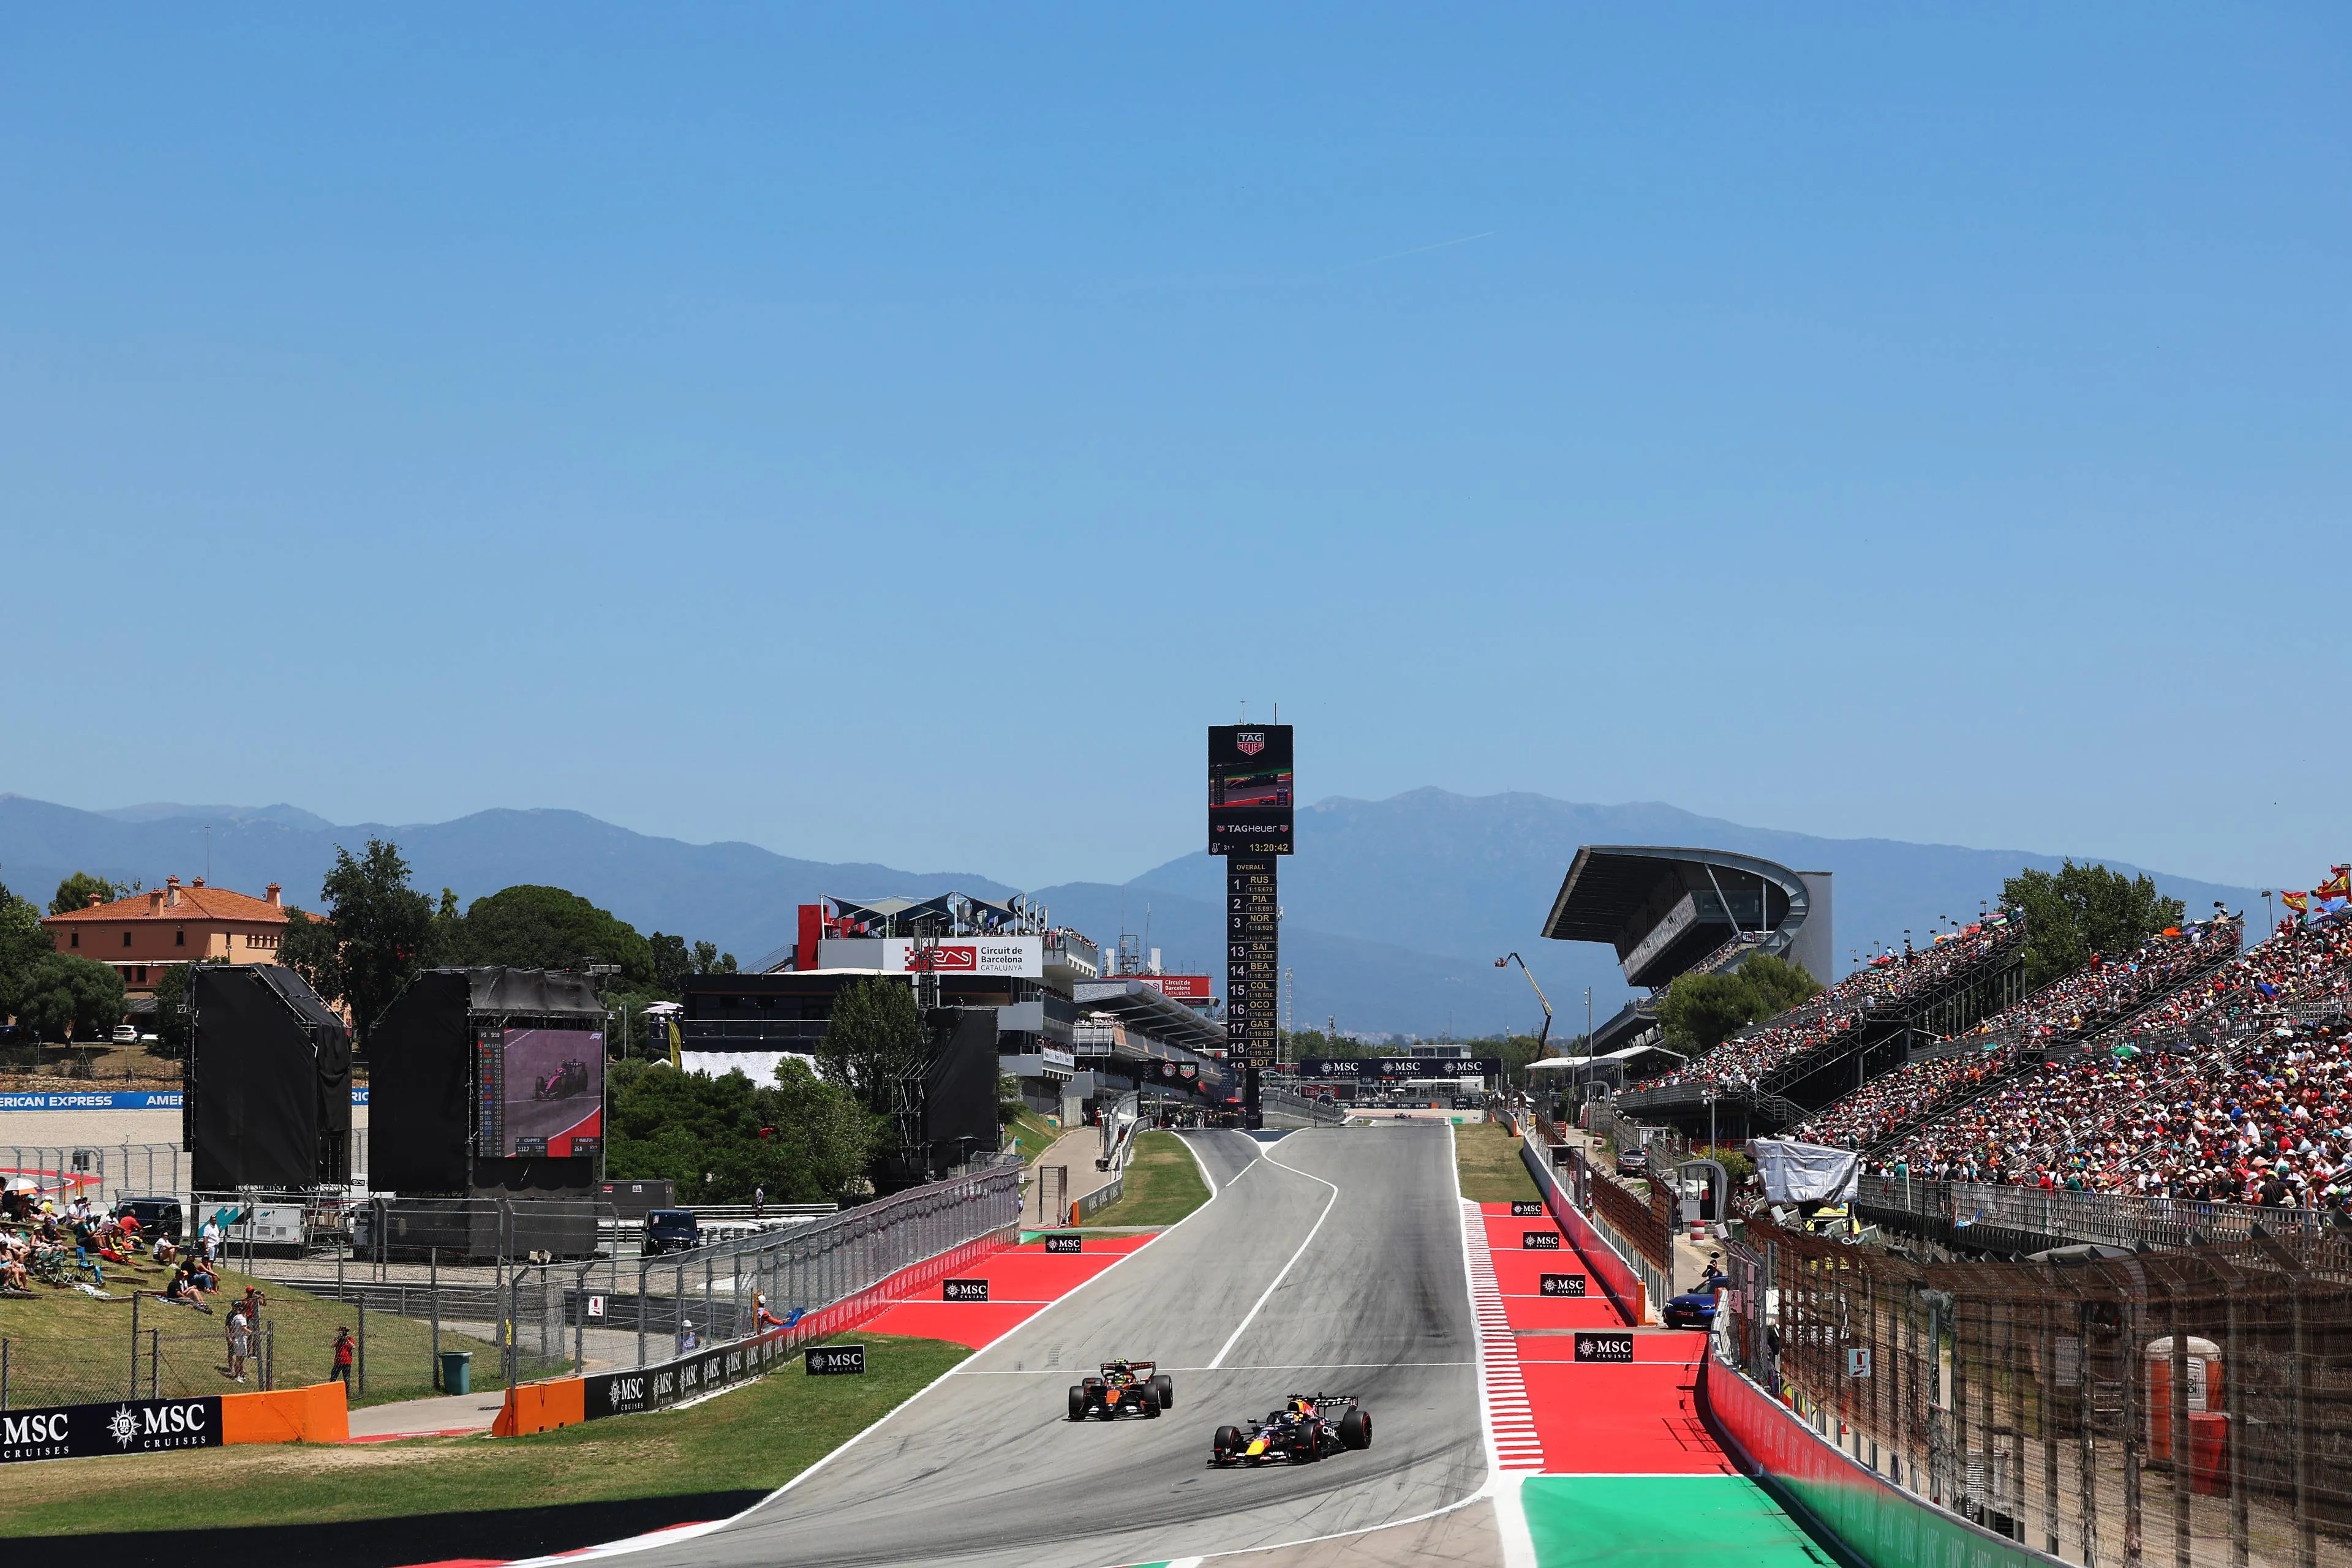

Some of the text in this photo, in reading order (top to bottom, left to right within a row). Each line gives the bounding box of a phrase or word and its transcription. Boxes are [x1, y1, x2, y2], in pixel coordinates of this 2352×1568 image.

[1239, 743, 1262, 753] HEUER
[1234, 879, 1239, 889] 1
[1234, 899, 1241, 909] 2
[1234, 918, 1241, 928] 3
[1231, 946, 1245, 957] 13
[1231, 965, 1245, 976] 14
[1231, 985, 1245, 995] 15
[1231, 1004, 1245, 1014] 16
[1231, 1023, 1245, 1033] 17
[1231, 1042, 1245, 1053] 18
[1334, 1062, 1359, 1071] MSC
[1395, 1062, 1420, 1071] MSC
[1457, 1061, 1482, 1071] MSC
[49, 1096, 113, 1107] EXPRESS
[1058, 1239, 1080, 1248] MSC
[960, 1285, 986, 1294] MSC
[1558, 1280, 1584, 1289] MSC
[1597, 1340, 1631, 1352] MSC
[731, 1350, 742, 1372] MSC
[827, 1353, 862, 1366] MSC
[709, 1357, 720, 1379] MSC
[685, 1364, 698, 1387] MSC
[660, 1371, 673, 1394] MSC
[621, 1378, 643, 1400] MSC
[621, 1402, 643, 1411] CRUISES
[143, 1404, 205, 1434] MSC
[2, 1413, 69, 1444] MSC
[144, 1436, 206, 1449] CRUISES
[4, 1446, 69, 1458] CRUISES
